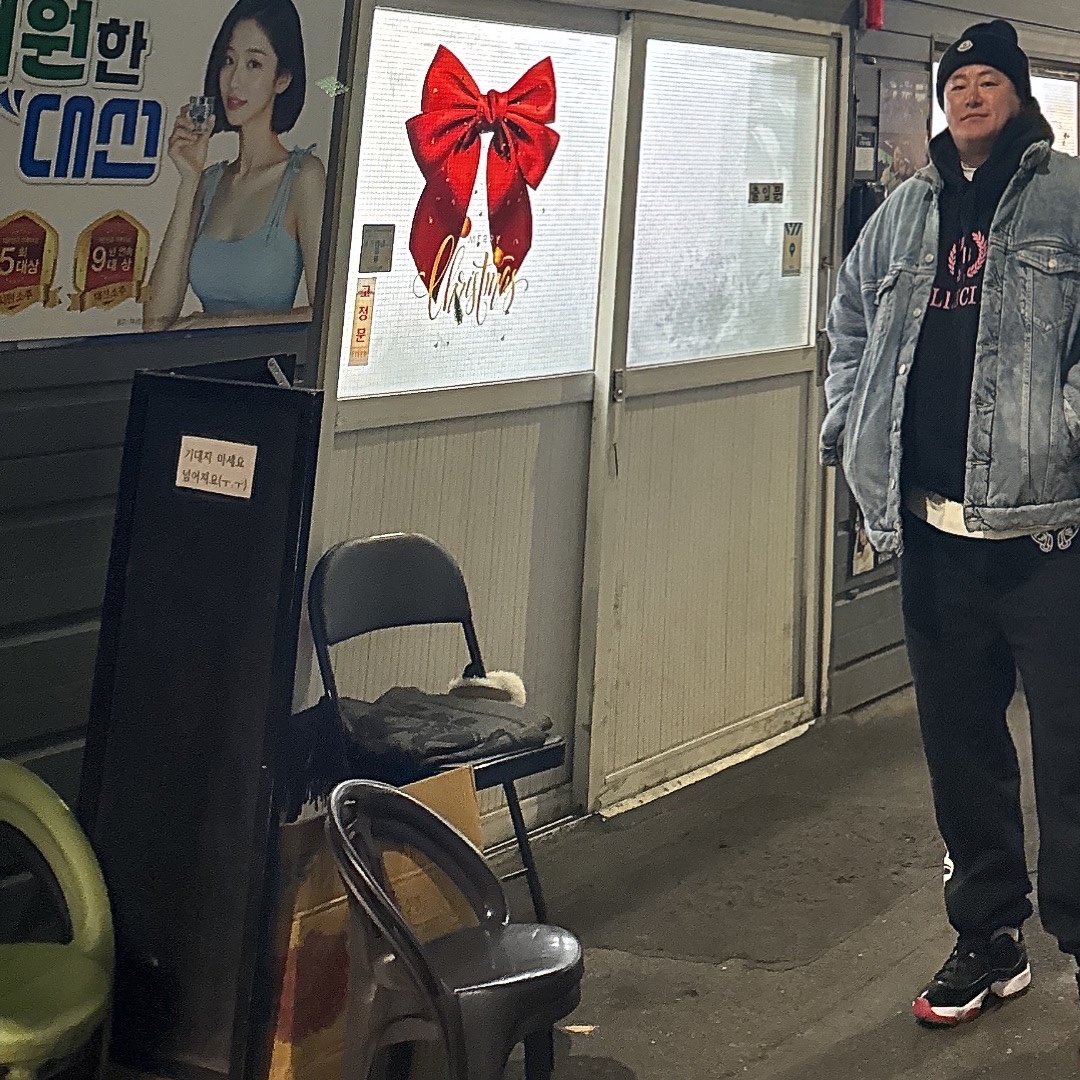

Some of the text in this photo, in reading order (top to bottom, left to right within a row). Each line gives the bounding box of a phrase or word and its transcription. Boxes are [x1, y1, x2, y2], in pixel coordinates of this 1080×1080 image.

[19, 93, 162, 179] 대선
[185, 449, 244, 467] 기대지 마세요
